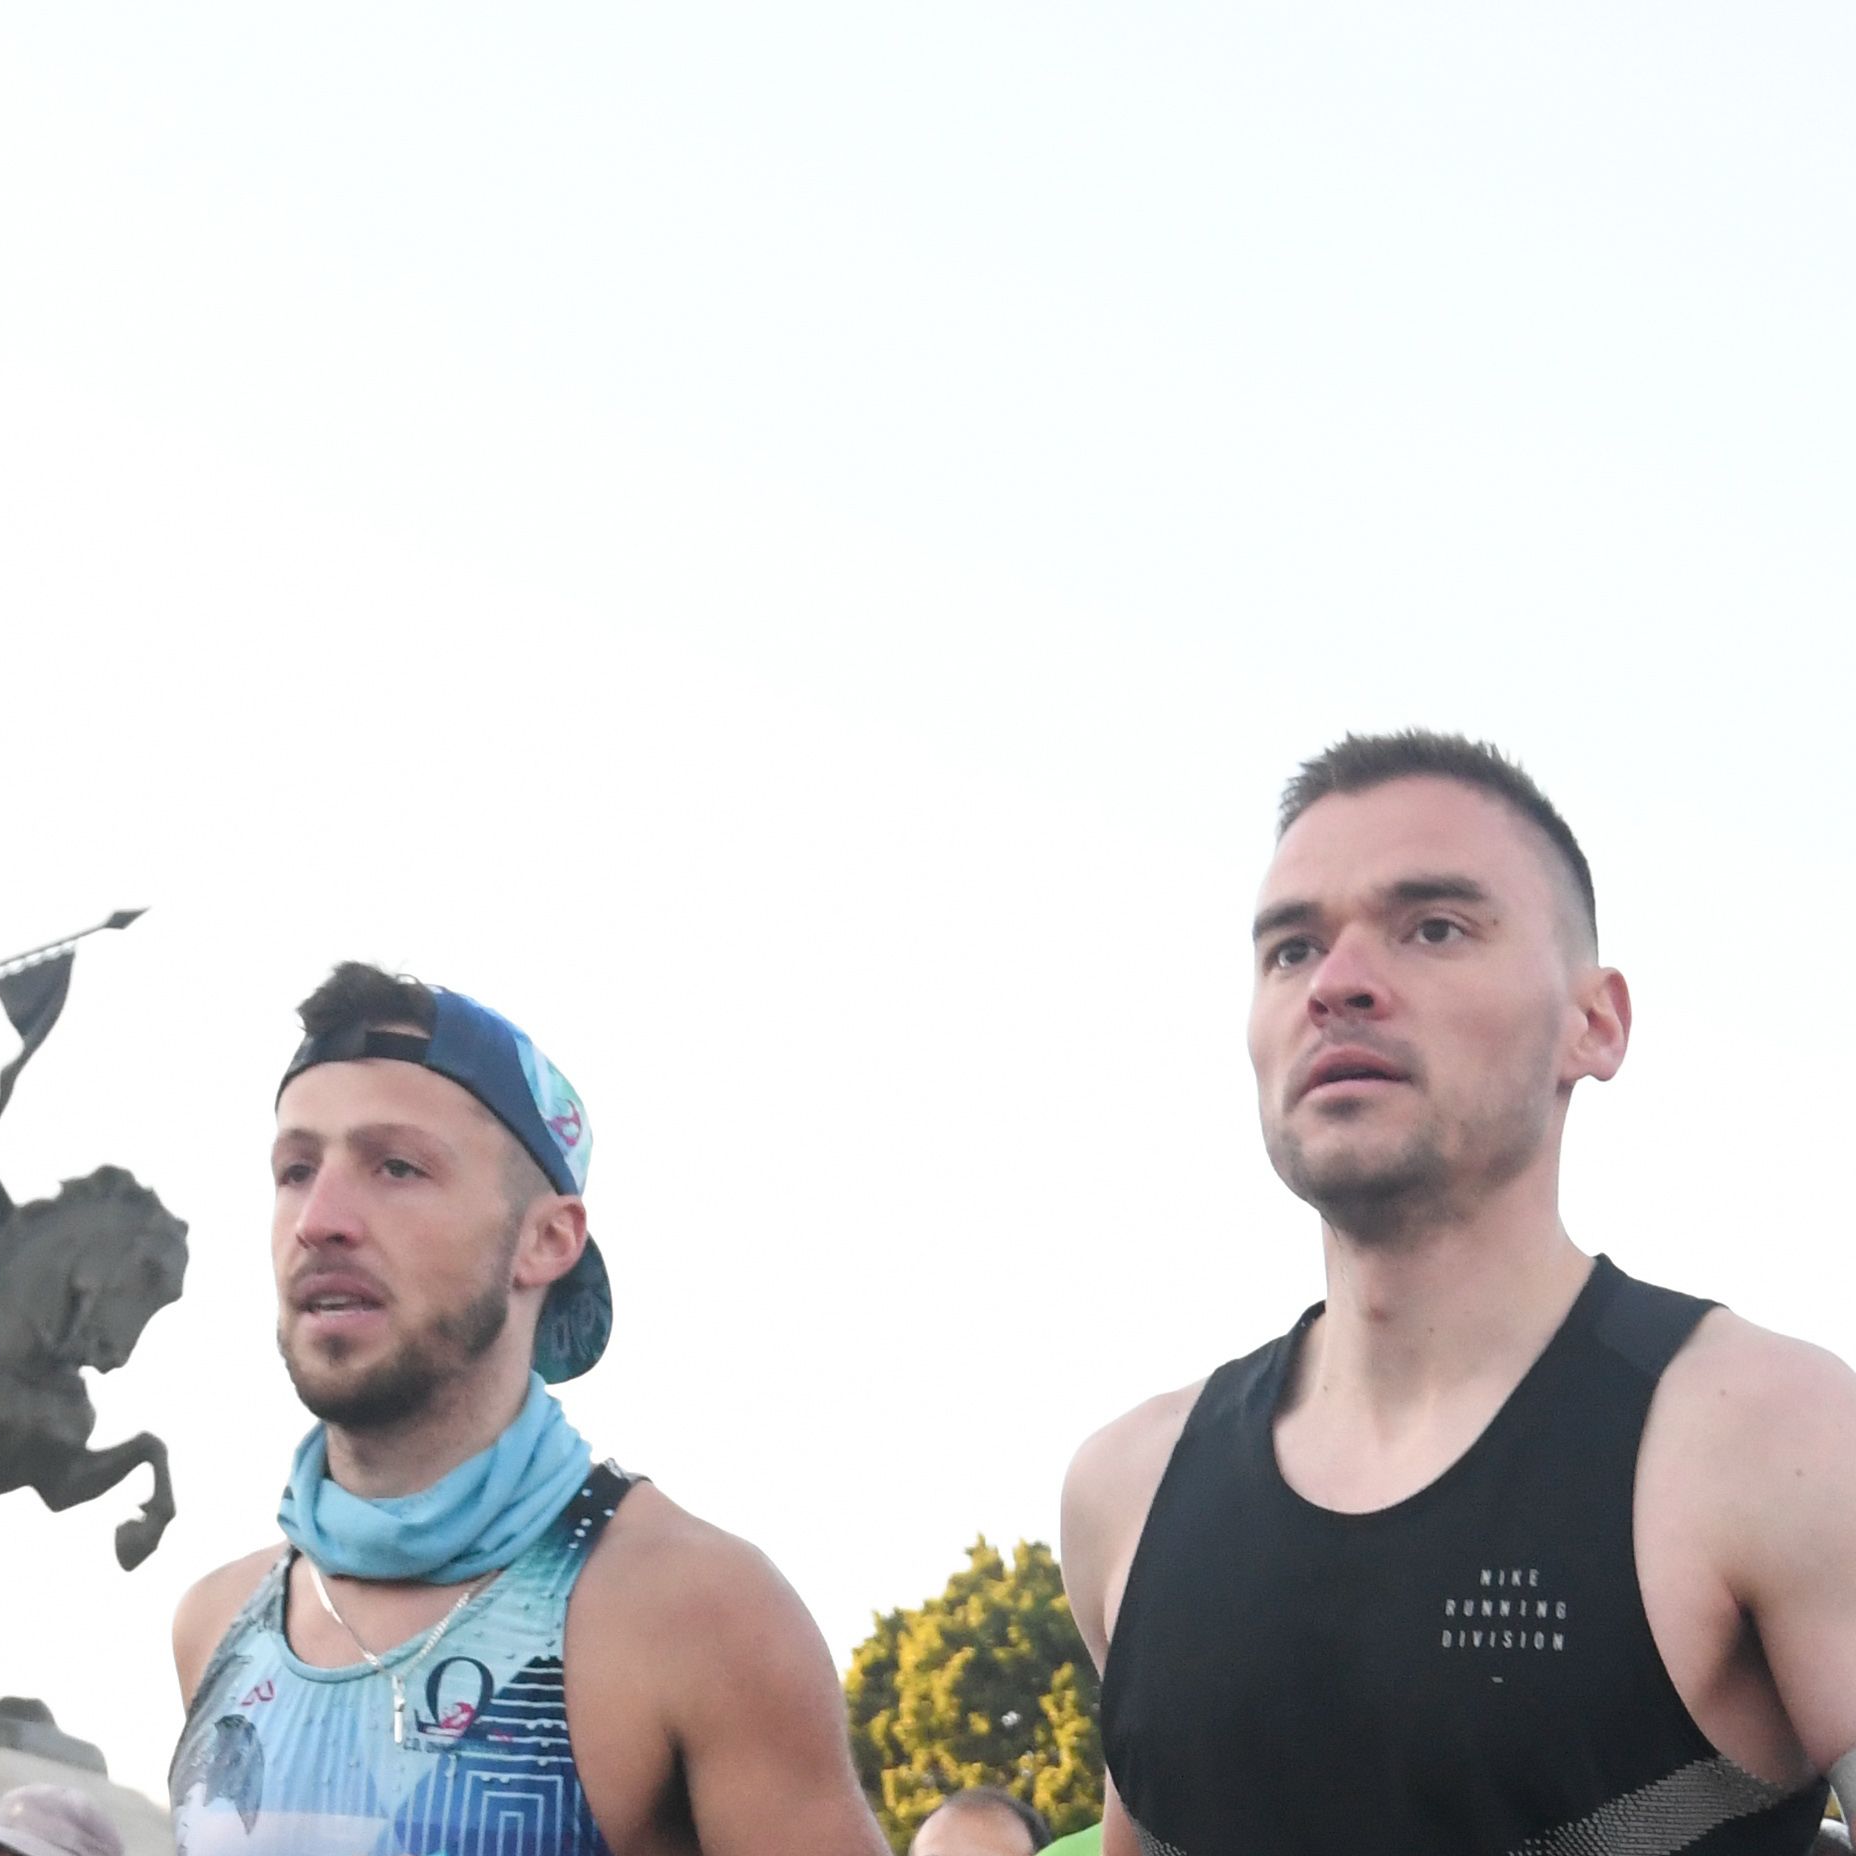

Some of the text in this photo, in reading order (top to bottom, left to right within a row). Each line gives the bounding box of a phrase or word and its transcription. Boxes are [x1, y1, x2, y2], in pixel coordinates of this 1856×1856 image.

[1480, 1568, 1540, 1588] NIKE
[1444, 1598, 1568, 1621] RUNNING
[1441, 1629, 1566, 1652] DIVISION
